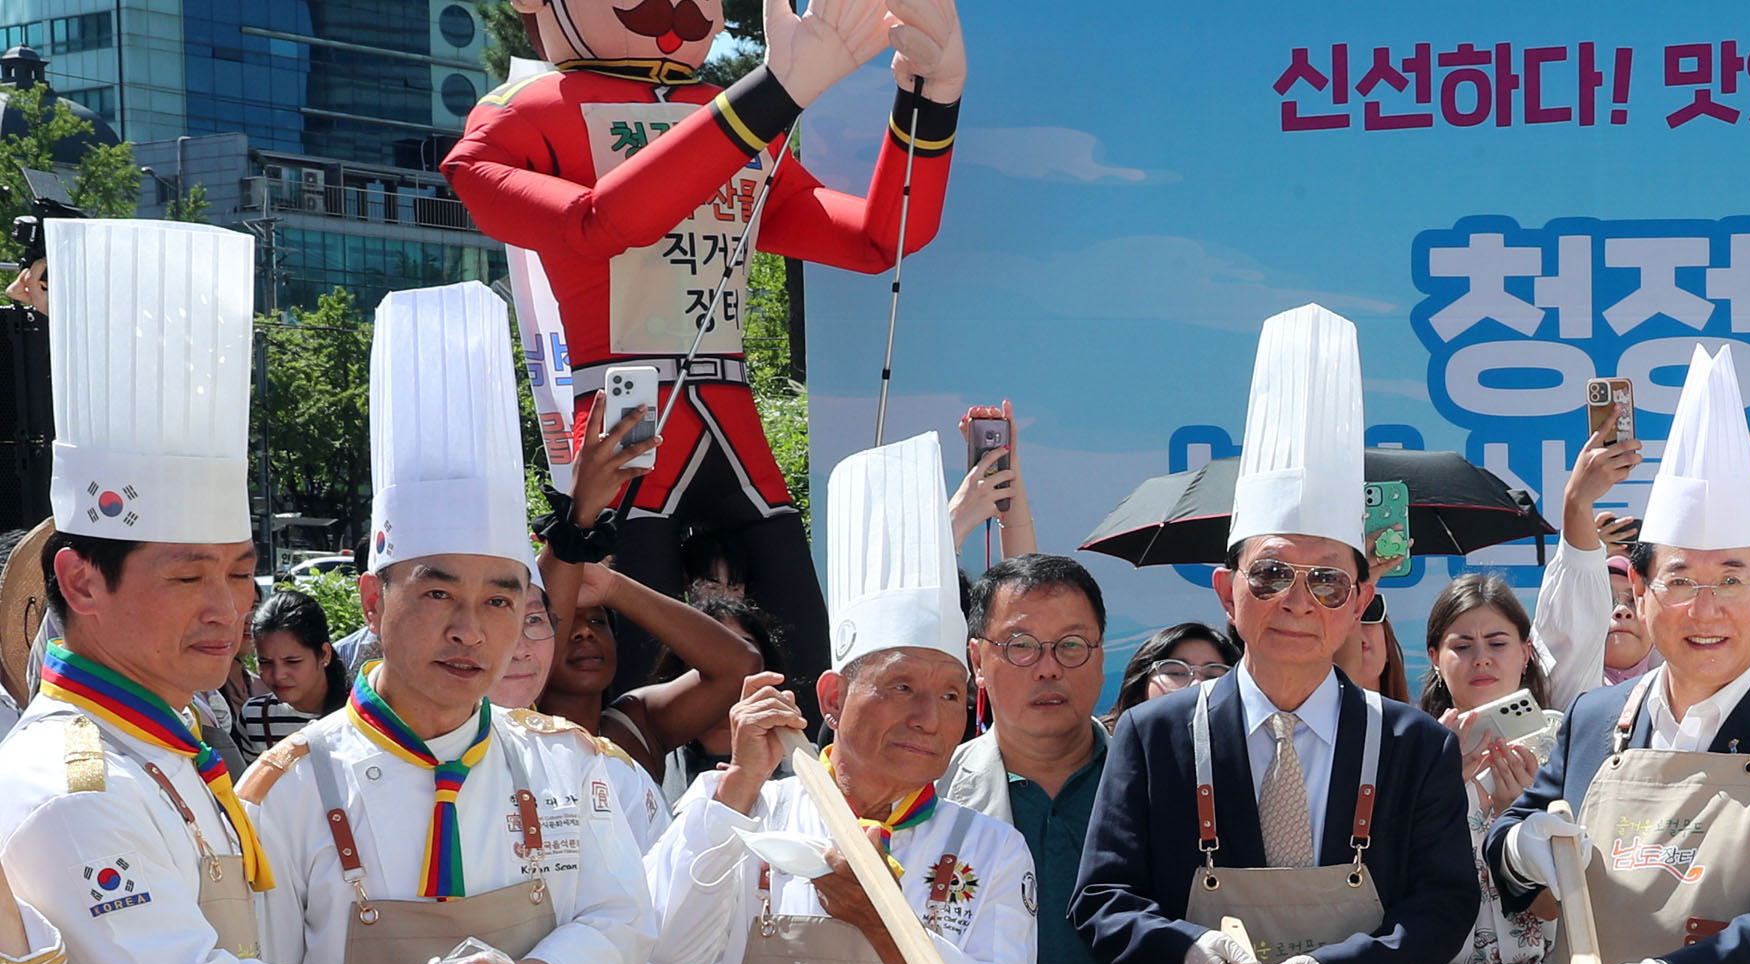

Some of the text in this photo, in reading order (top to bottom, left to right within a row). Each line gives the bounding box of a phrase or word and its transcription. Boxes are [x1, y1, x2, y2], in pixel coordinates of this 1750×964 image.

[1273, 43, 1633, 132] 신선하다!
[685, 287, 740, 333] 장터
[1611, 837, 1698, 872] 남도장터
[93, 894, 146, 915] KOREA
